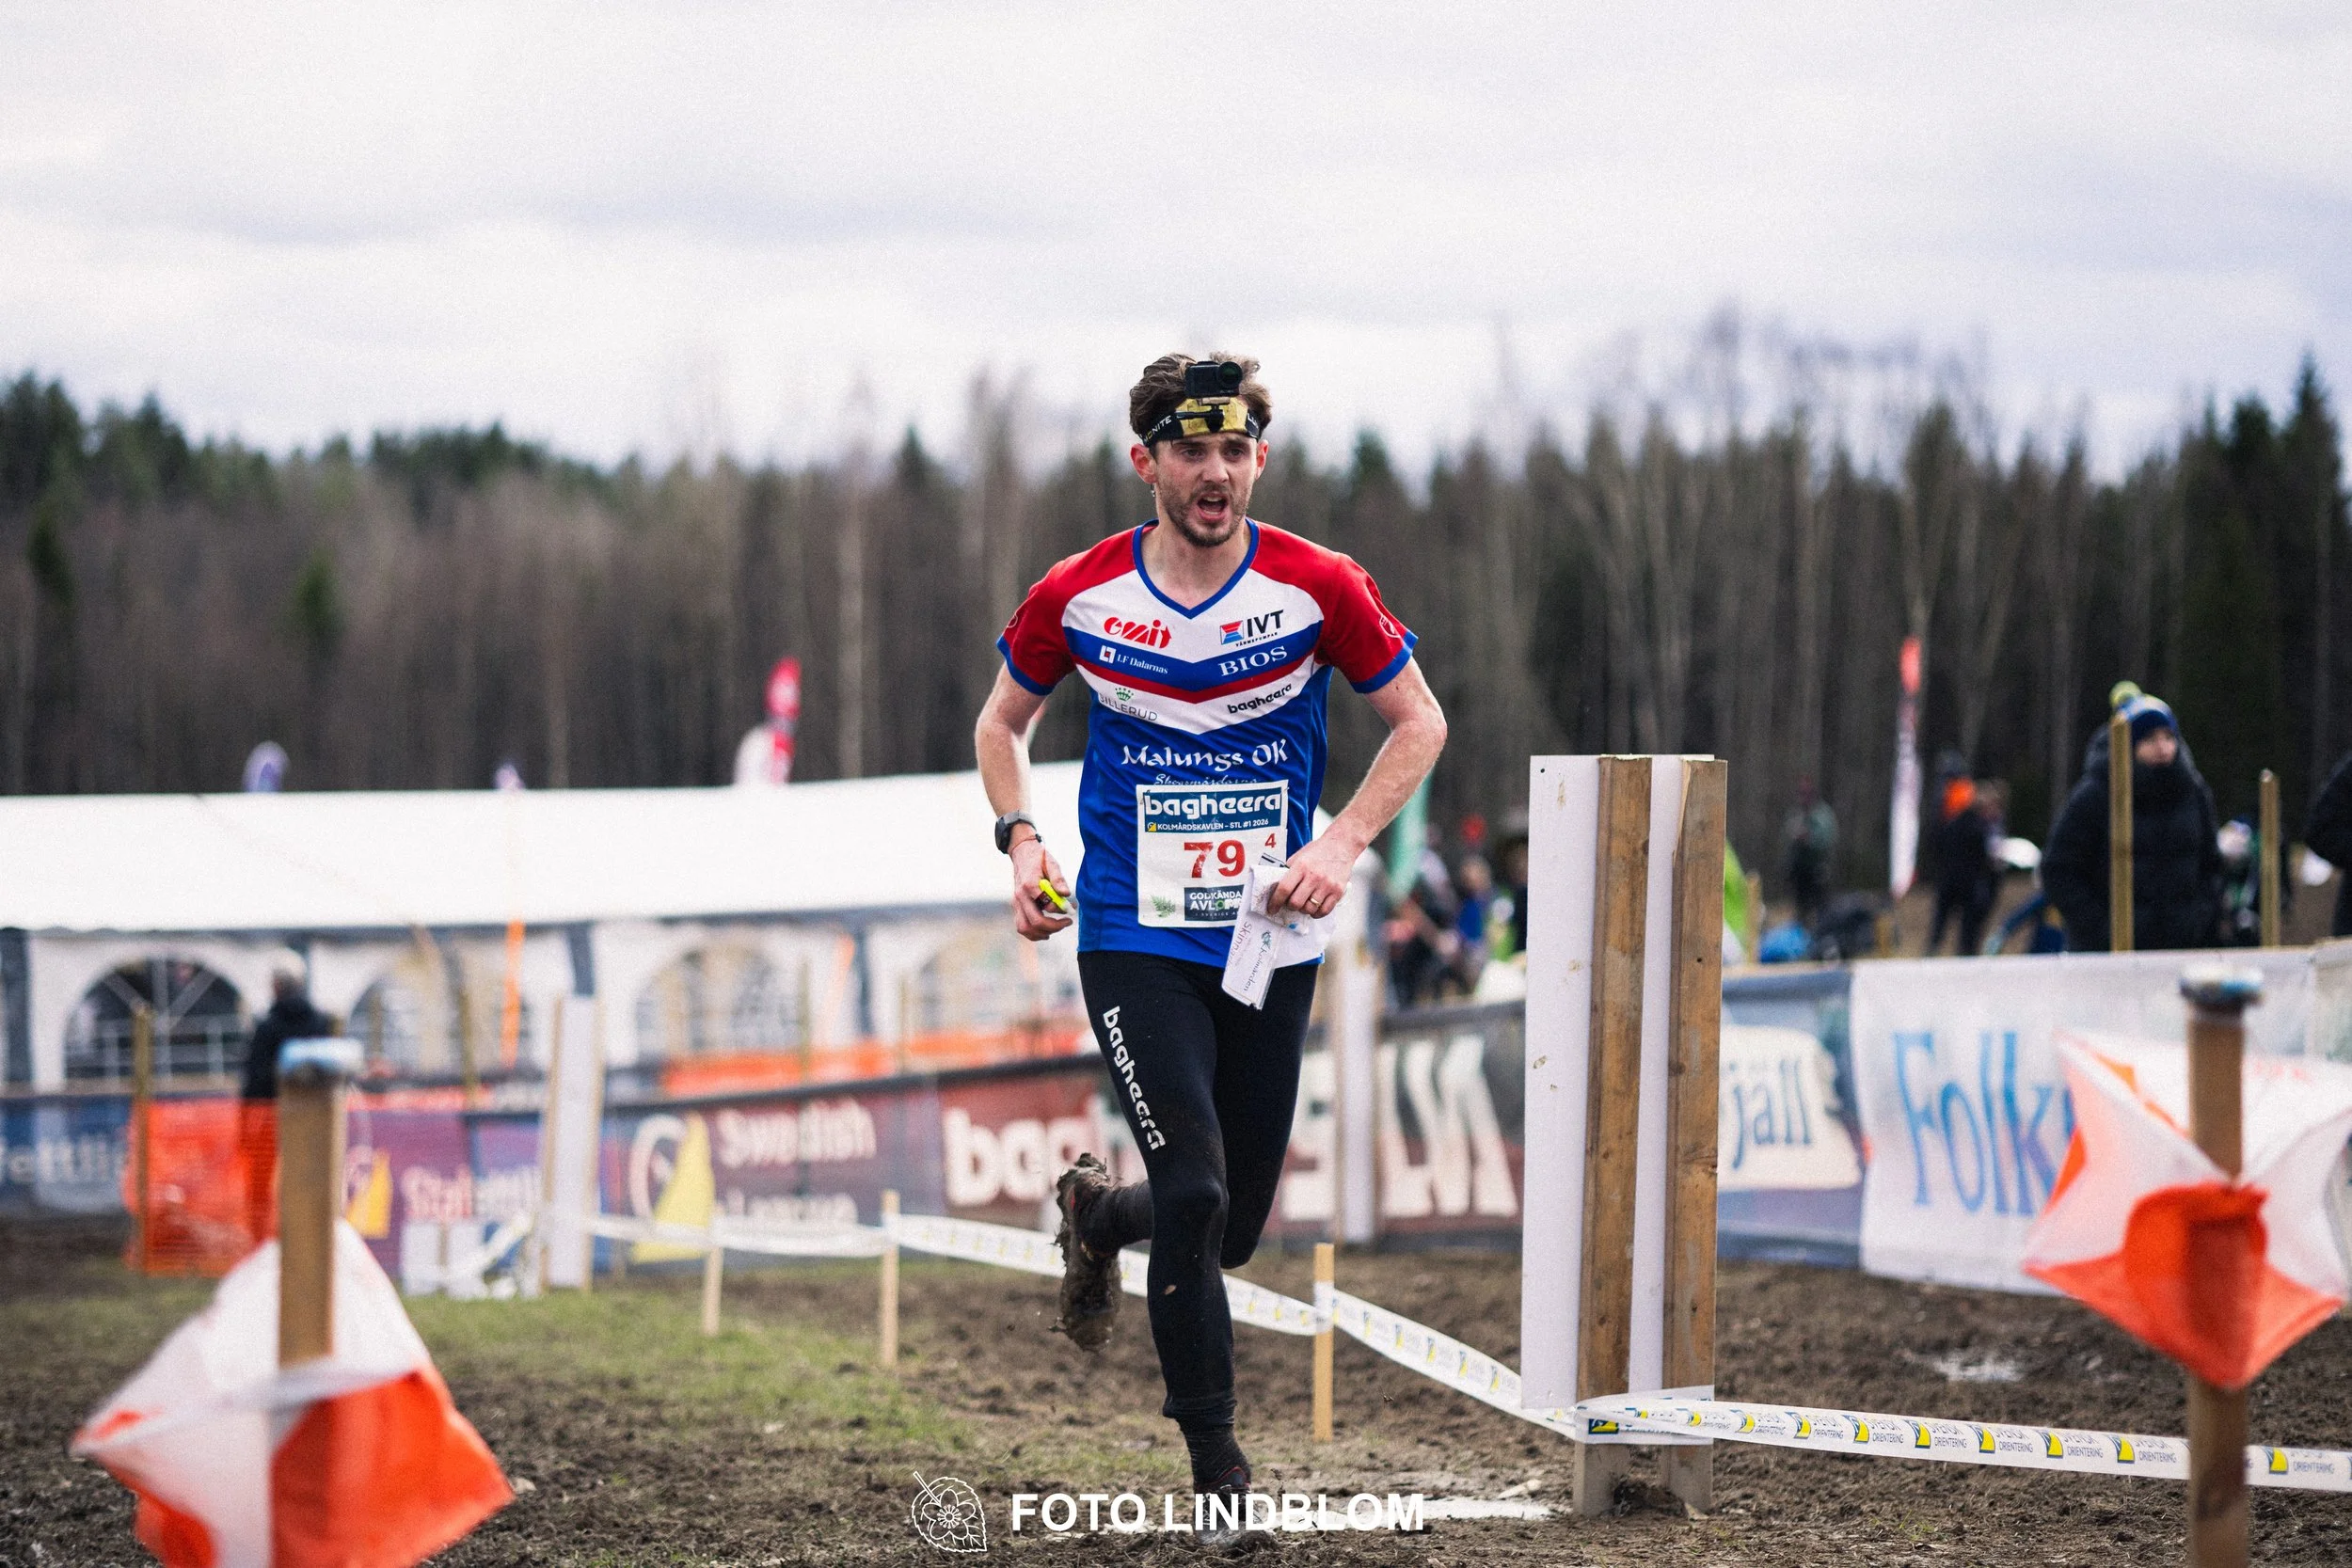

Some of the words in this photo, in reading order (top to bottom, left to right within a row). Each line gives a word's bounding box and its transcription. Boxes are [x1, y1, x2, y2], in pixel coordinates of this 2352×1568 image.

[1247, 610, 1283, 638] IVT
[1117, 654, 1130, 664] LF
[1130, 657, 1168, 674] Dalarnas
[1217, 645, 1288, 676] BIOS
[1227, 683, 1292, 714] bagheera
[1120, 745, 1244, 772] Malungs
[1251, 738, 1288, 767] OK
[1144, 793, 1281, 820] bagheera
[1157, 822, 1223, 832] KOLMÅRDSKAVLEN
[1253, 818, 1269, 827] 2026
[1264, 832, 1277, 848] 4
[1184, 839, 1246, 879] 79
[1189, 890, 1243, 900] GODKÄNDA
[1103, 1006, 1166, 1150] bagheera
[1933, 1436, 1967, 1449] ORIENTERING
[1998, 1441, 2034, 1453] ORIENTERING
[2067, 1446, 2105, 1459] ORIENTERING
[2138, 1450, 2178, 1464] ORIENTERING
